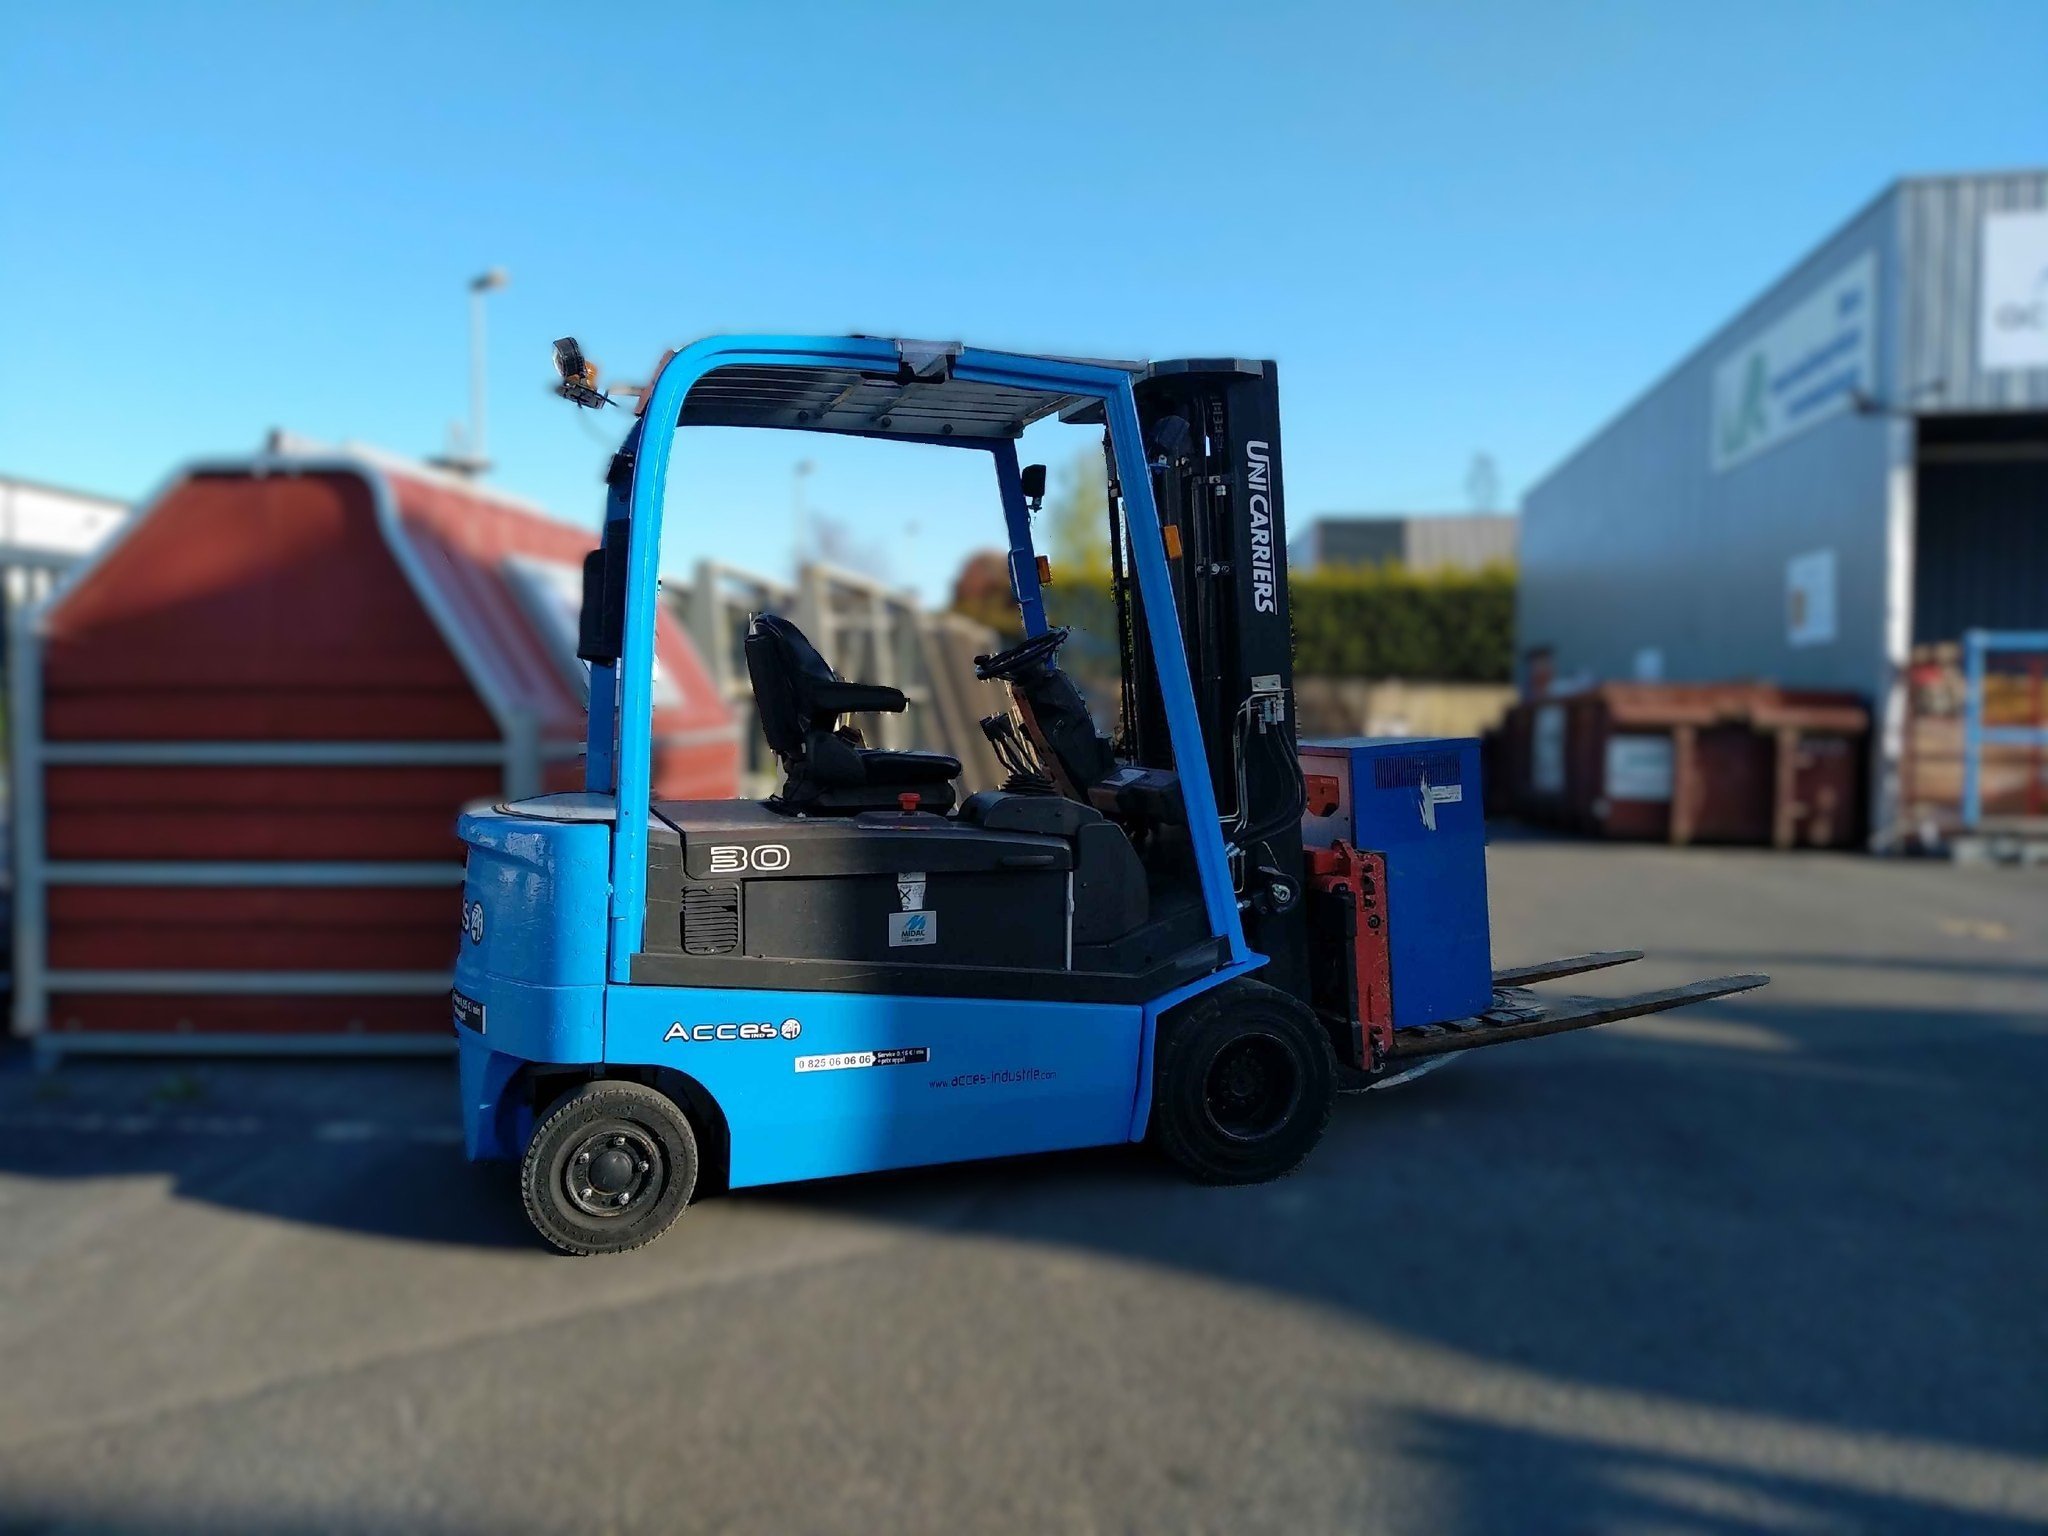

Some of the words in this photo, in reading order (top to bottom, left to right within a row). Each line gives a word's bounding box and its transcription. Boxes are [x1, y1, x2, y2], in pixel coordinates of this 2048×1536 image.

[710, 844, 791, 873] 30
[901, 929, 926, 937] MIDAC
[663, 1021, 778, 1042] Acces
[799, 1060, 804, 1069] 0
[807, 1058, 826, 1068] 825
[829, 1057, 841, 1066] 06
[844, 1056, 856, 1065] 06
[860, 1055, 871, 1064] 06
